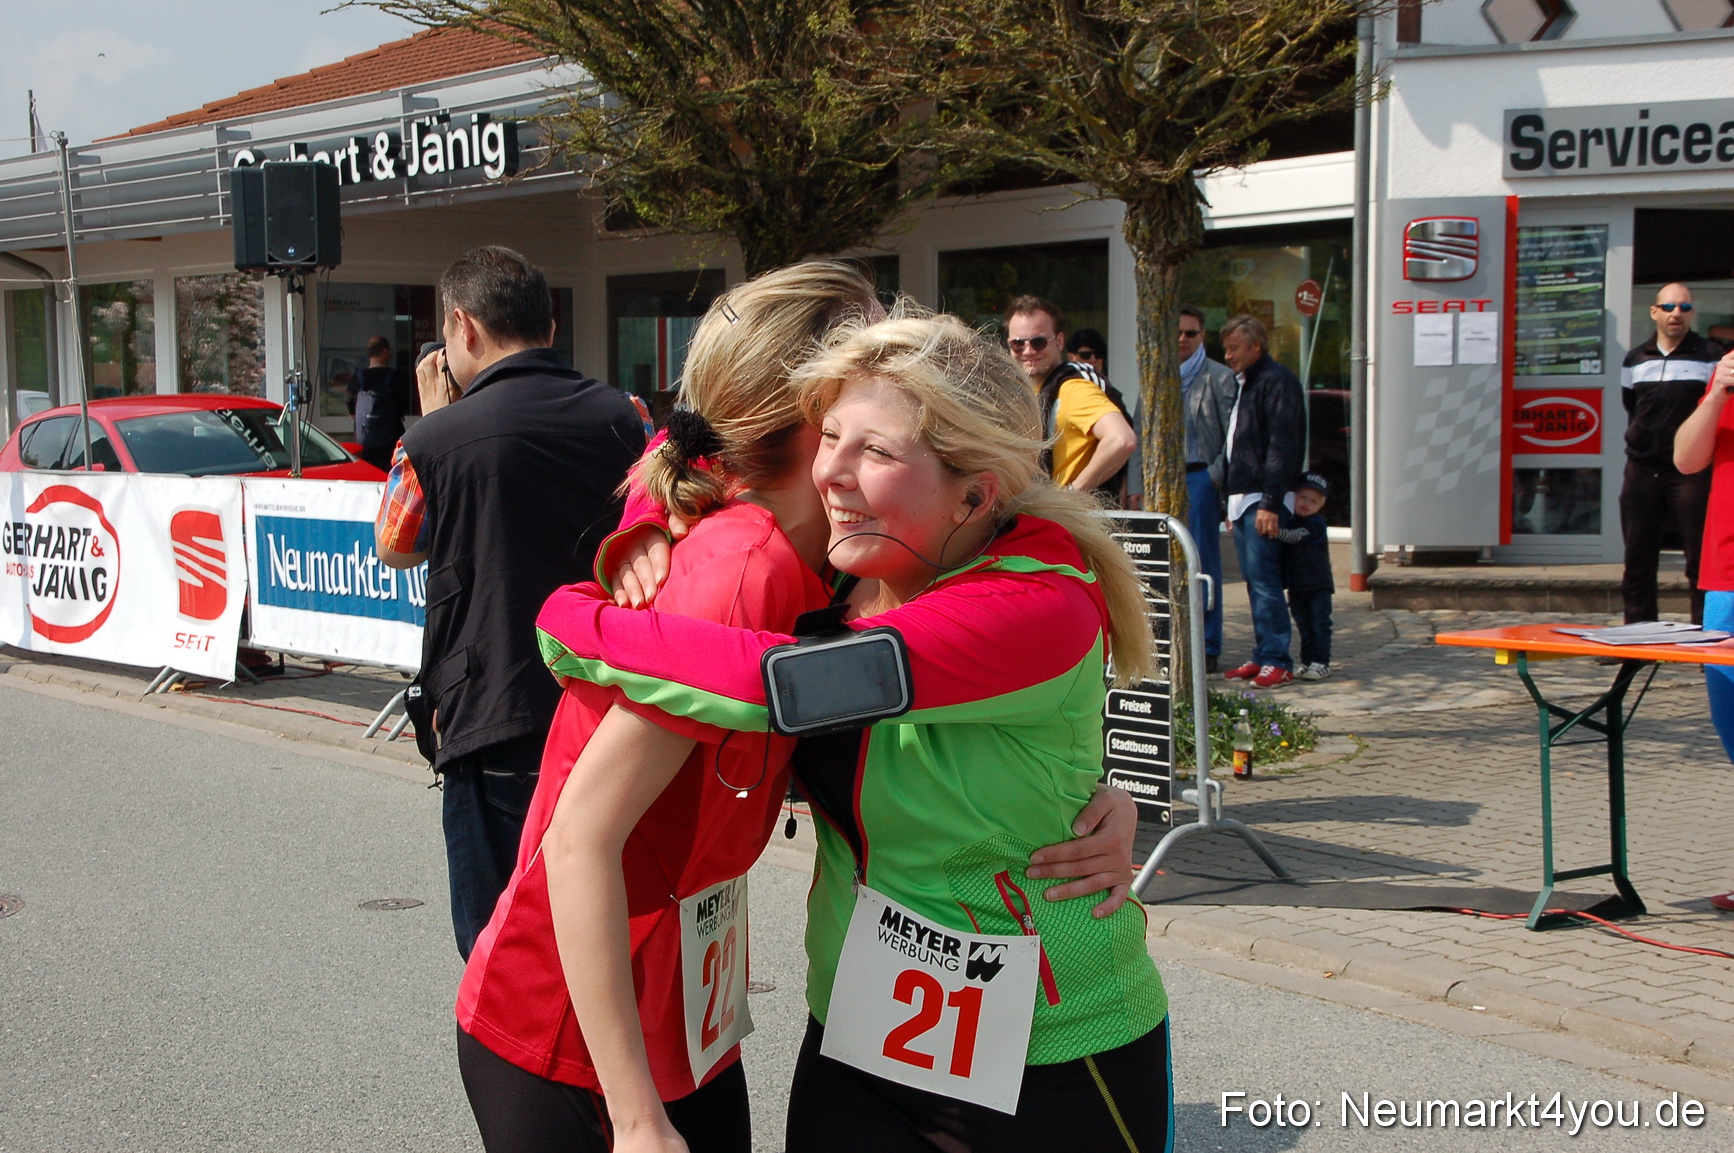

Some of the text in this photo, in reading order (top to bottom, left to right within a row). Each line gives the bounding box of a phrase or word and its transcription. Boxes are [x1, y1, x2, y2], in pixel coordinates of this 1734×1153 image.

[371, 130, 396, 181] &
[407, 113, 506, 179] Jänig
[1392, 299, 1494, 315] SEAT
[2, 521, 105, 562] GERHART &
[1123, 542, 1151, 554] Strom
[33, 563, 107, 602] JÄNIG
[1119, 698, 1152, 714] Freizeit
[1111, 736, 1158, 756] Stadtbusse
[1111, 777, 1159, 796] Parkhäuser
[696, 885, 730, 923] MEYER
[696, 909, 731, 938] WERBUNG
[879, 905, 962, 958] MEYER
[877, 925, 961, 972] WERBUNG
[701, 925, 736, 1053] 22
[882, 968, 984, 1079] 21
